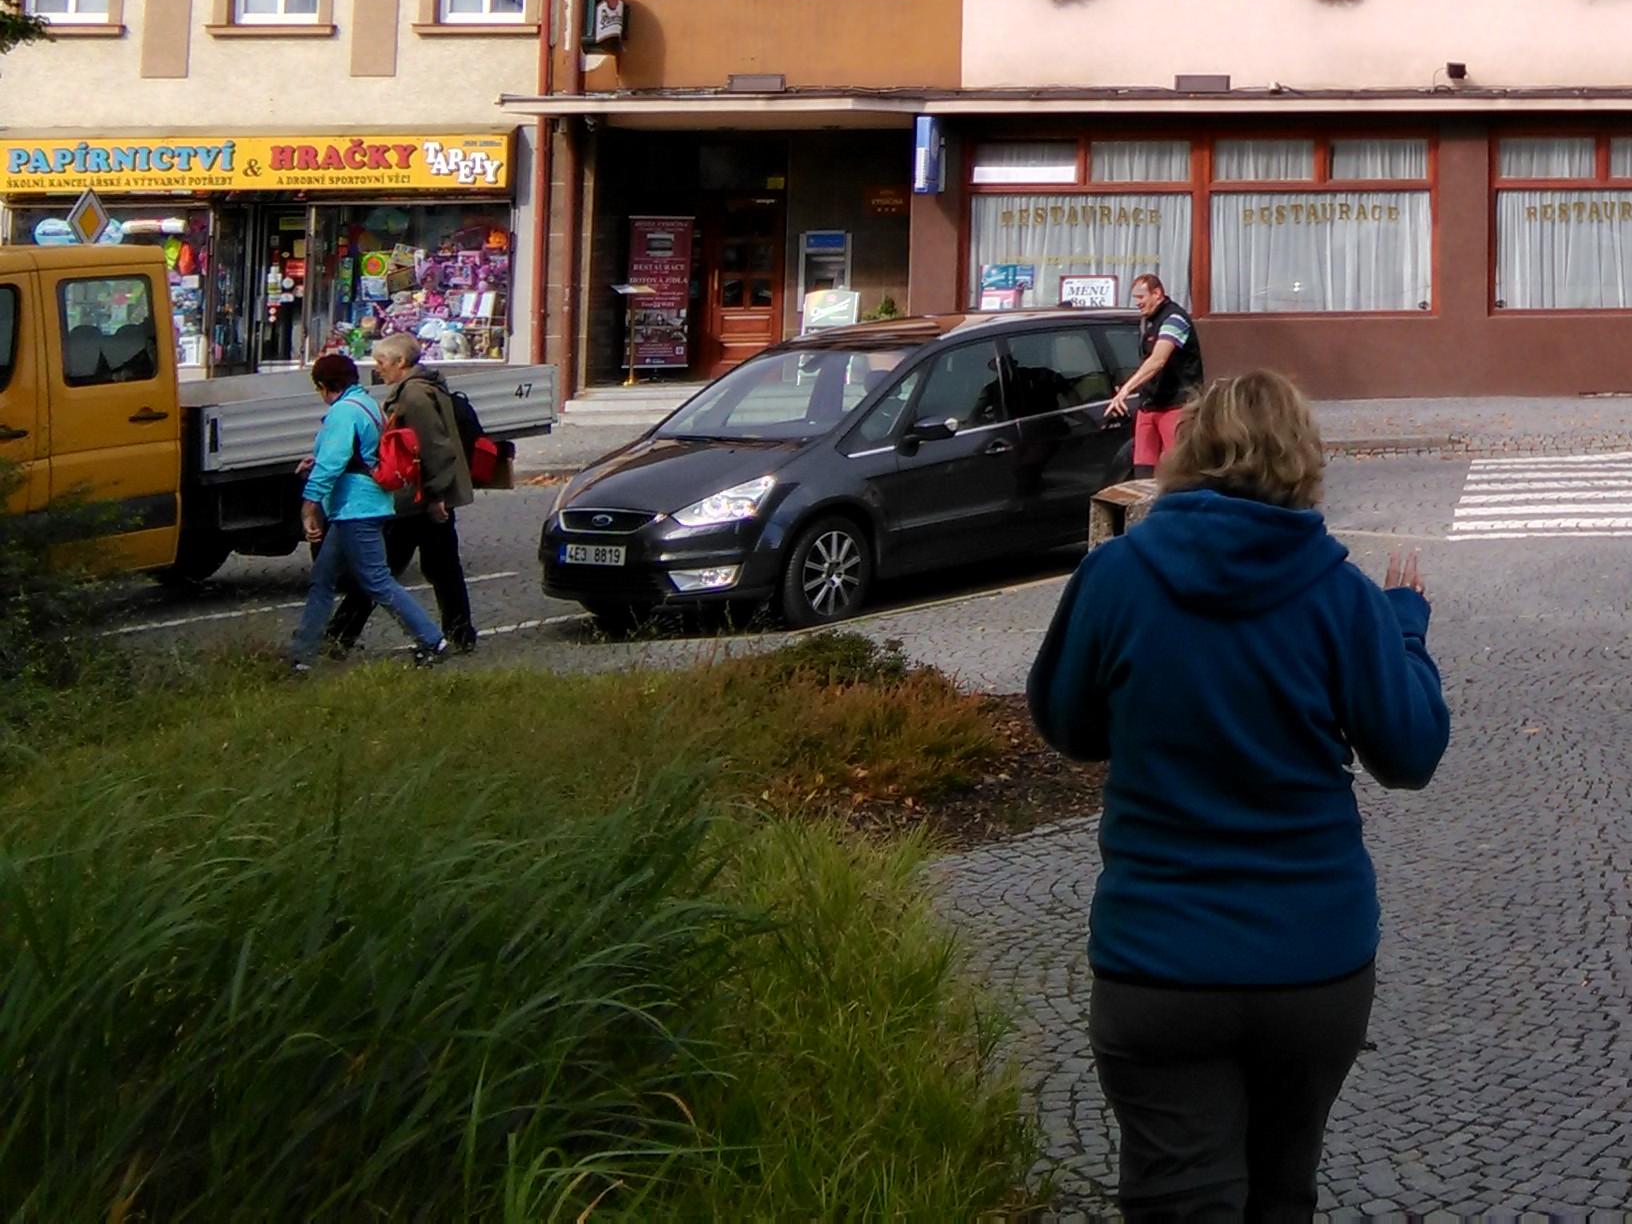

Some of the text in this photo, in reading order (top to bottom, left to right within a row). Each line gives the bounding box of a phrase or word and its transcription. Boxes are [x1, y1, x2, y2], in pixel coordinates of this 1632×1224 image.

[7, 138, 417, 178] PAPÍRNICTVÍ & HRAČKY
[423, 141, 503, 185] TAPETY
[188, 174, 233, 186] POTŘEBY
[276, 172, 411, 185] A DROBNÉ SPORTOVNÍ VĚCI
[1001, 205, 1162, 227] RESTAURACE
[1243, 202, 1400, 226] RESTAURACE
[1068, 286, 1110, 296] MENU
[514, 383, 532, 399] 47
[568, 546, 621, 563] 4E3 8819
